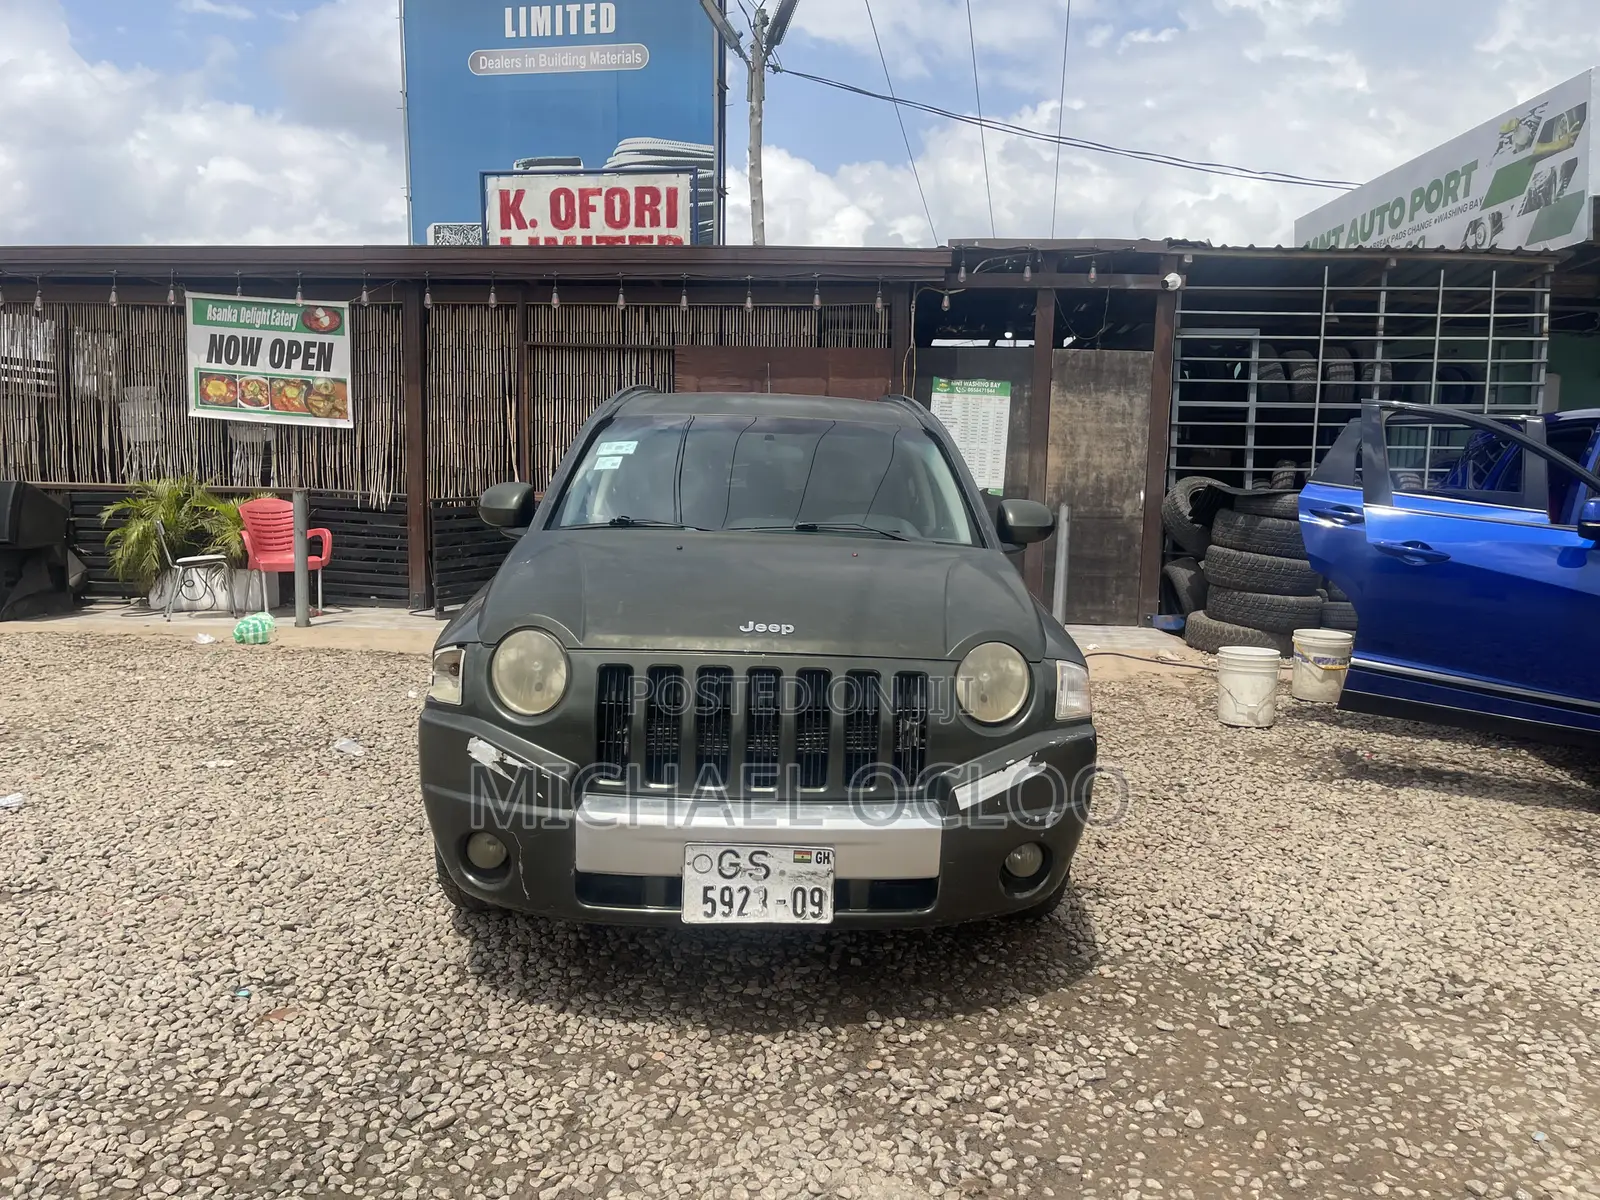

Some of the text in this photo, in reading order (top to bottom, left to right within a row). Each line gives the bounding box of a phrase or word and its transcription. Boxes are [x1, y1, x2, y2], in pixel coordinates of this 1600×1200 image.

[504, 2, 616, 38] LIMITED
[479, 49, 642, 70] Dealers in Building Materials
[499, 186, 679, 231] K. OFORI
[1345, 196, 1405, 248] AUTO
[1408, 159, 1478, 222] PORT
[1390, 229, 1407, 242] PADS
[1407, 218, 1433, 236] CHANGE
[1468, 196, 1484, 211] BAY
[207, 304, 299, 331] Asanka Delight Eatery
[206, 333, 335, 372] NOW OPEN
[739, 621, 795, 635] Jeep
[717, 849, 771, 881] GS
[815, 850, 831, 865] GH
